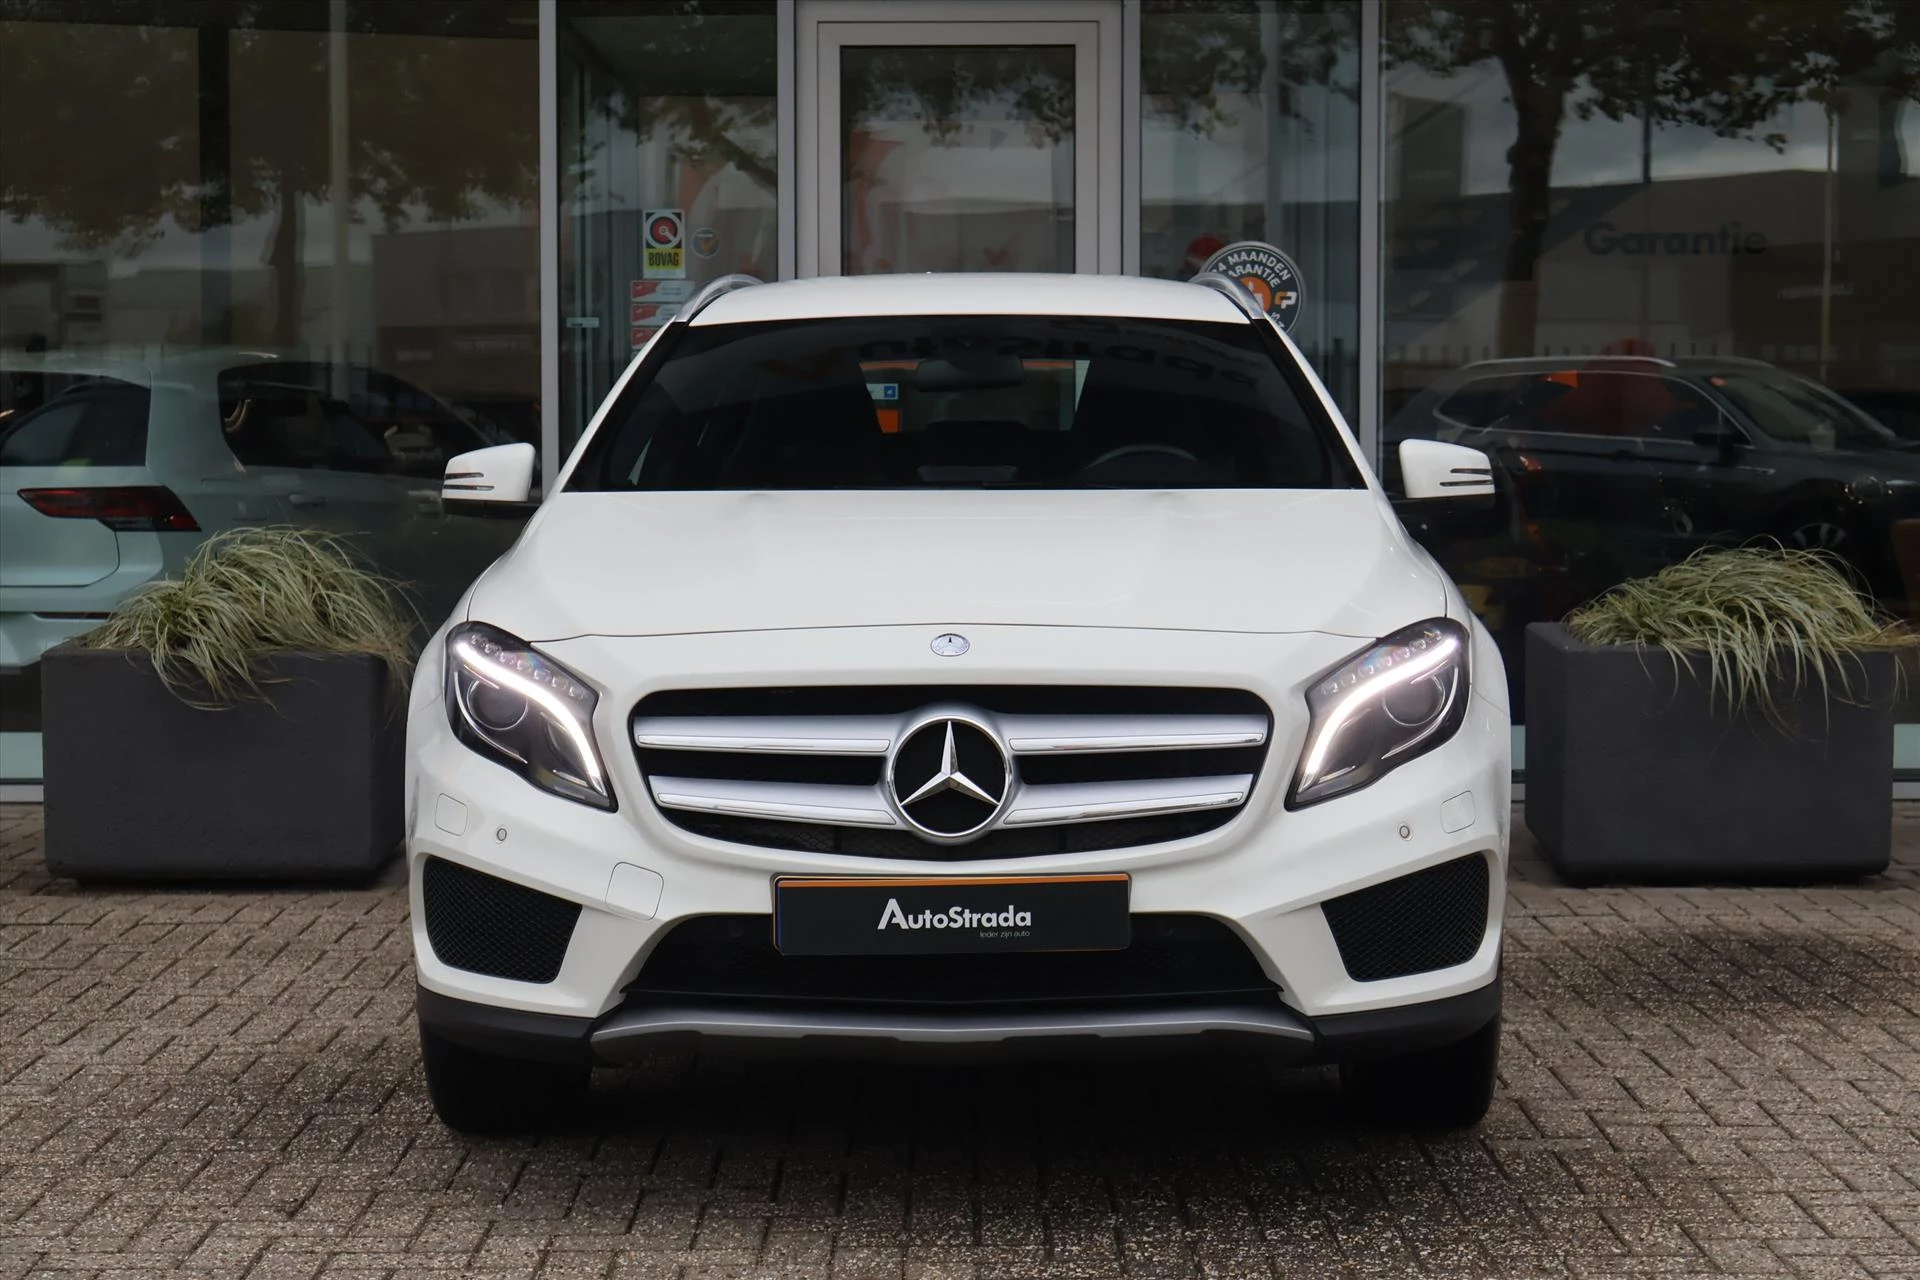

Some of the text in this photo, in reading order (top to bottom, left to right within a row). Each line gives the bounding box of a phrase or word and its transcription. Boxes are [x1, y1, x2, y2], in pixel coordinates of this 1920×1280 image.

[1584, 220, 1767, 257] Garantie
[648, 251, 679, 267] BOVAG
[1228, 251, 1291, 281] MAANDEN
[1228, 264, 1280, 288] ARANTIE
[877, 898, 1032, 930] AutoStrada
[1014, 930, 1031, 938] auto
